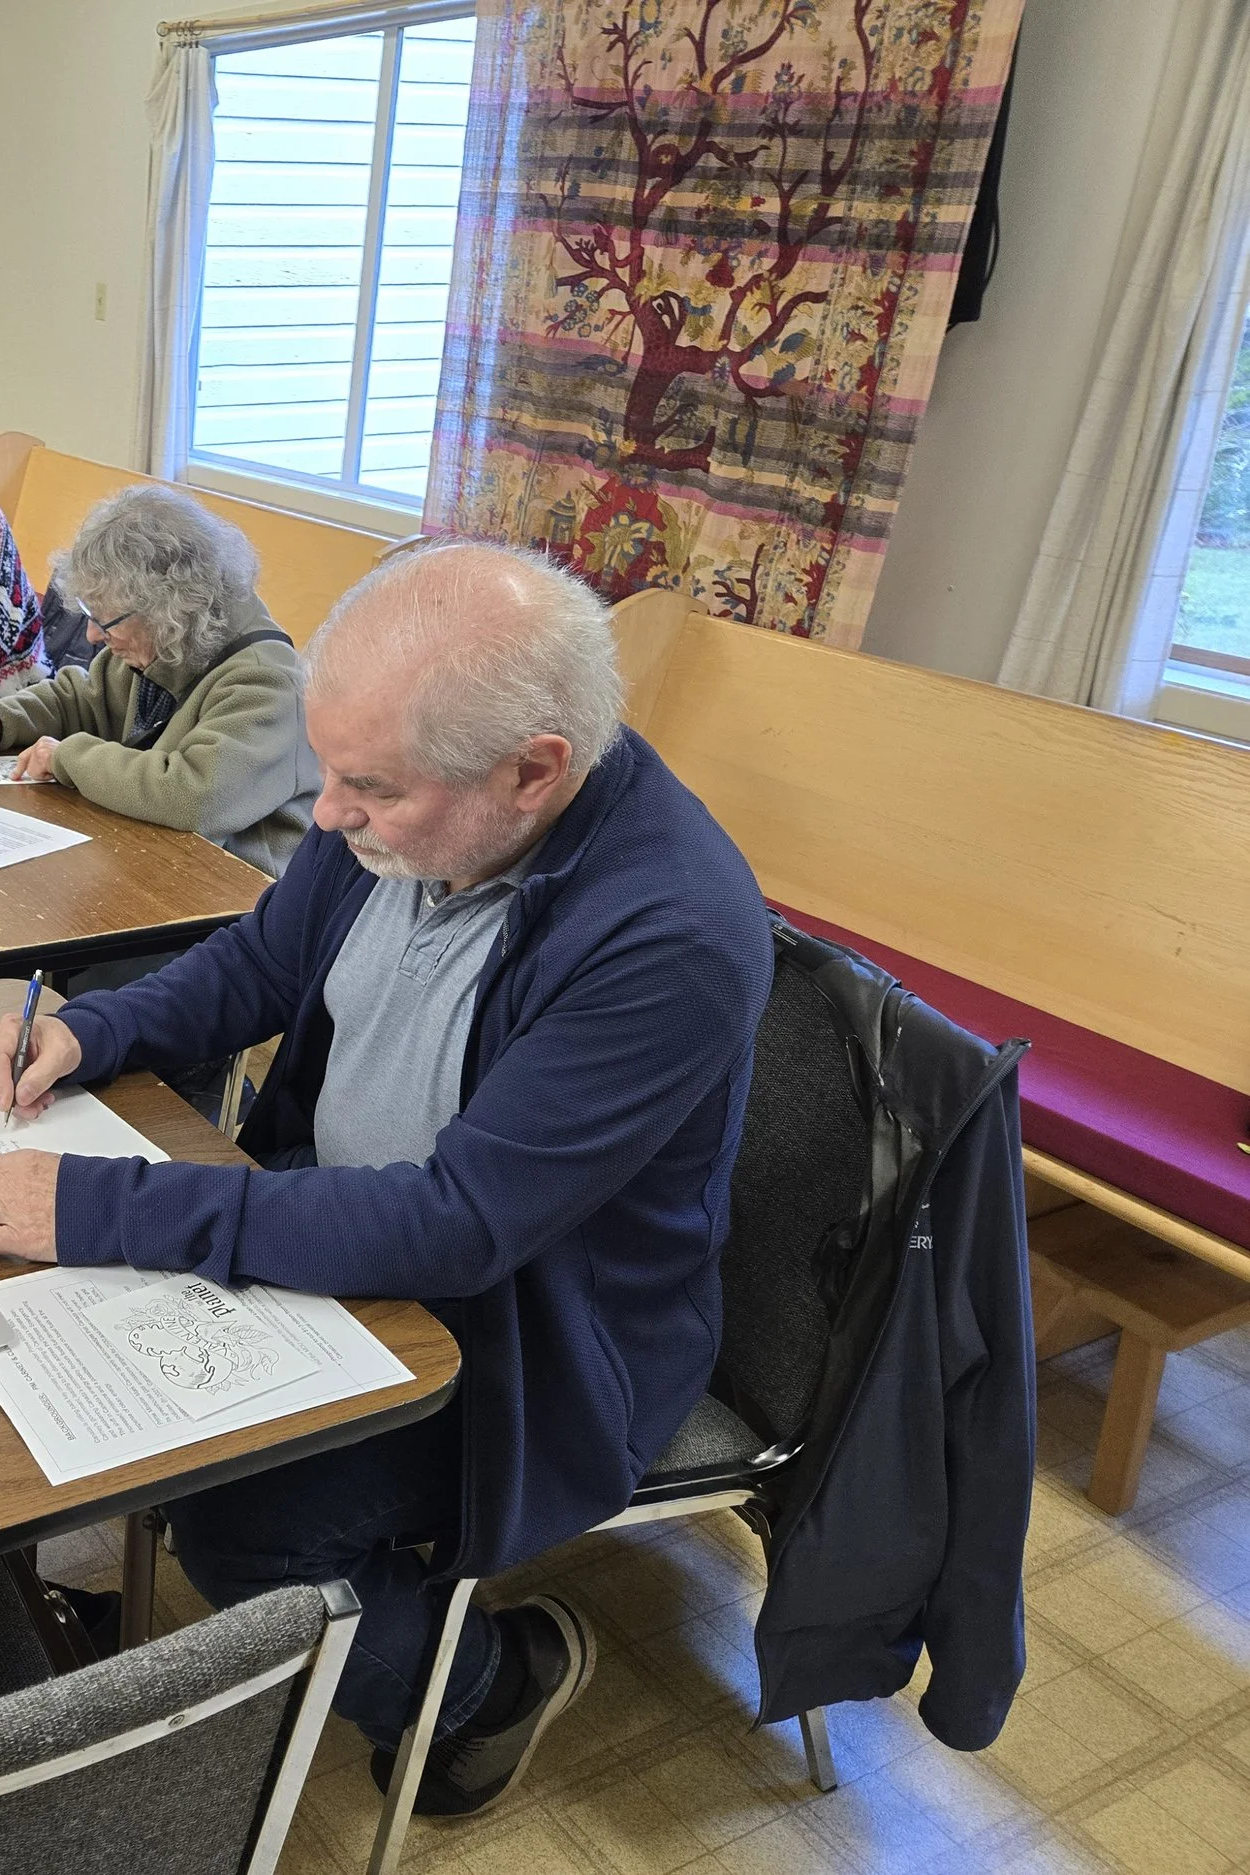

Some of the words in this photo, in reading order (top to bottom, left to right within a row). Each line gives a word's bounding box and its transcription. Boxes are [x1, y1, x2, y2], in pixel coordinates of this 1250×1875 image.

[162, 1317, 227, 1356] VALENTINE
[15, 1361, 32, 1382] CARNEY
[30, 1382, 38, 1390] PM
[38, 1392, 76, 1440] BACKGROUNDER:
